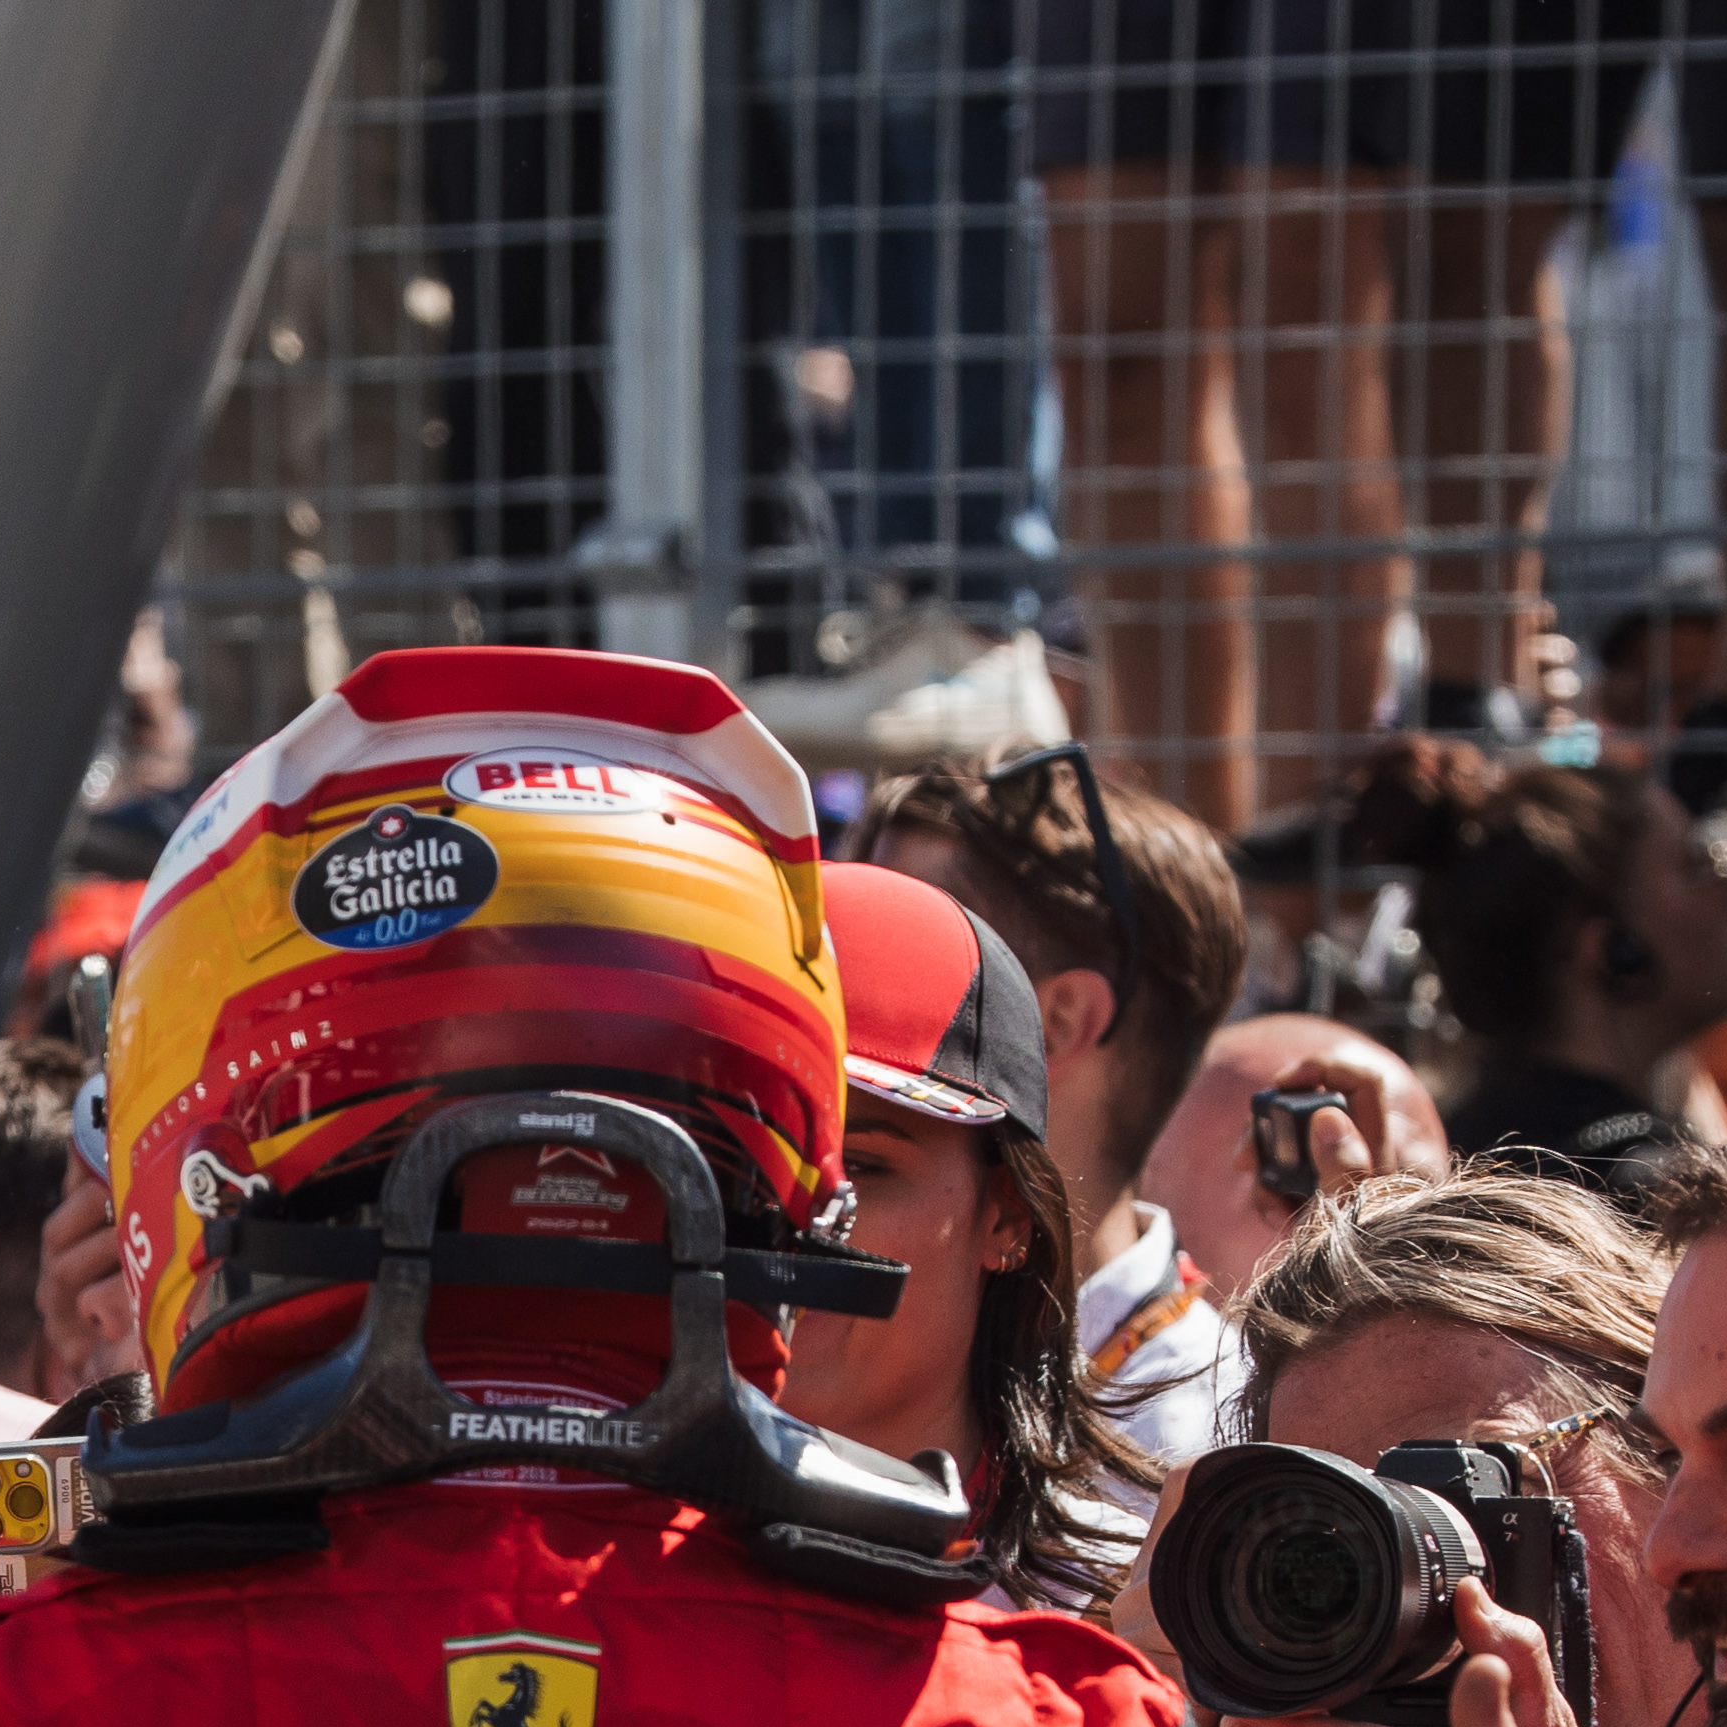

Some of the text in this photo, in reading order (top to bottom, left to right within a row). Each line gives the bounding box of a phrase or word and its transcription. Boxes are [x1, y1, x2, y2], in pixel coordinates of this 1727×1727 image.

[475, 762, 630, 798] BELL
[324, 837, 463, 889] Estrella
[329, 869, 458, 921] Galicia
[226, 1020, 333, 1079] SAINZ
[448, 1411, 645, 1449] FEATHERLITE
